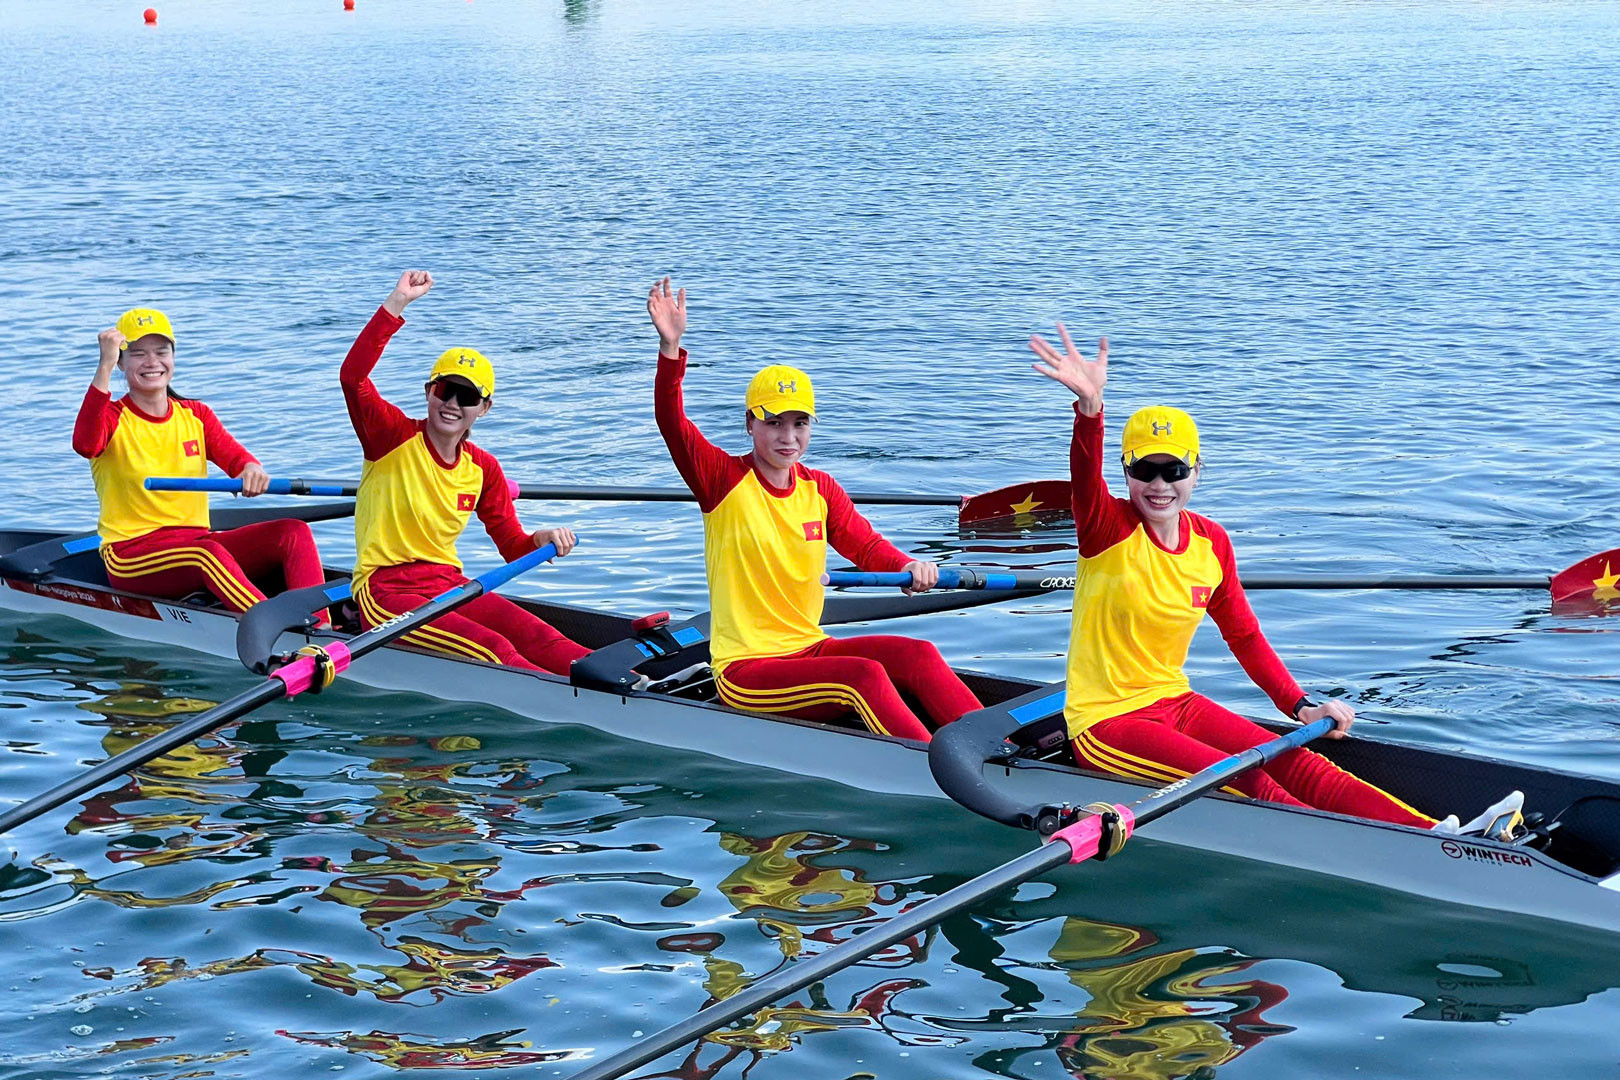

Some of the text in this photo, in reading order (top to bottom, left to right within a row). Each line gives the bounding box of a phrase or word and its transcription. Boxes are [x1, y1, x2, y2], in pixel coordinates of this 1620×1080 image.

[1040, 576, 1077, 588] CROKE
[167, 607, 192, 624] VIE
[1461, 845, 1533, 867] WINTECH
